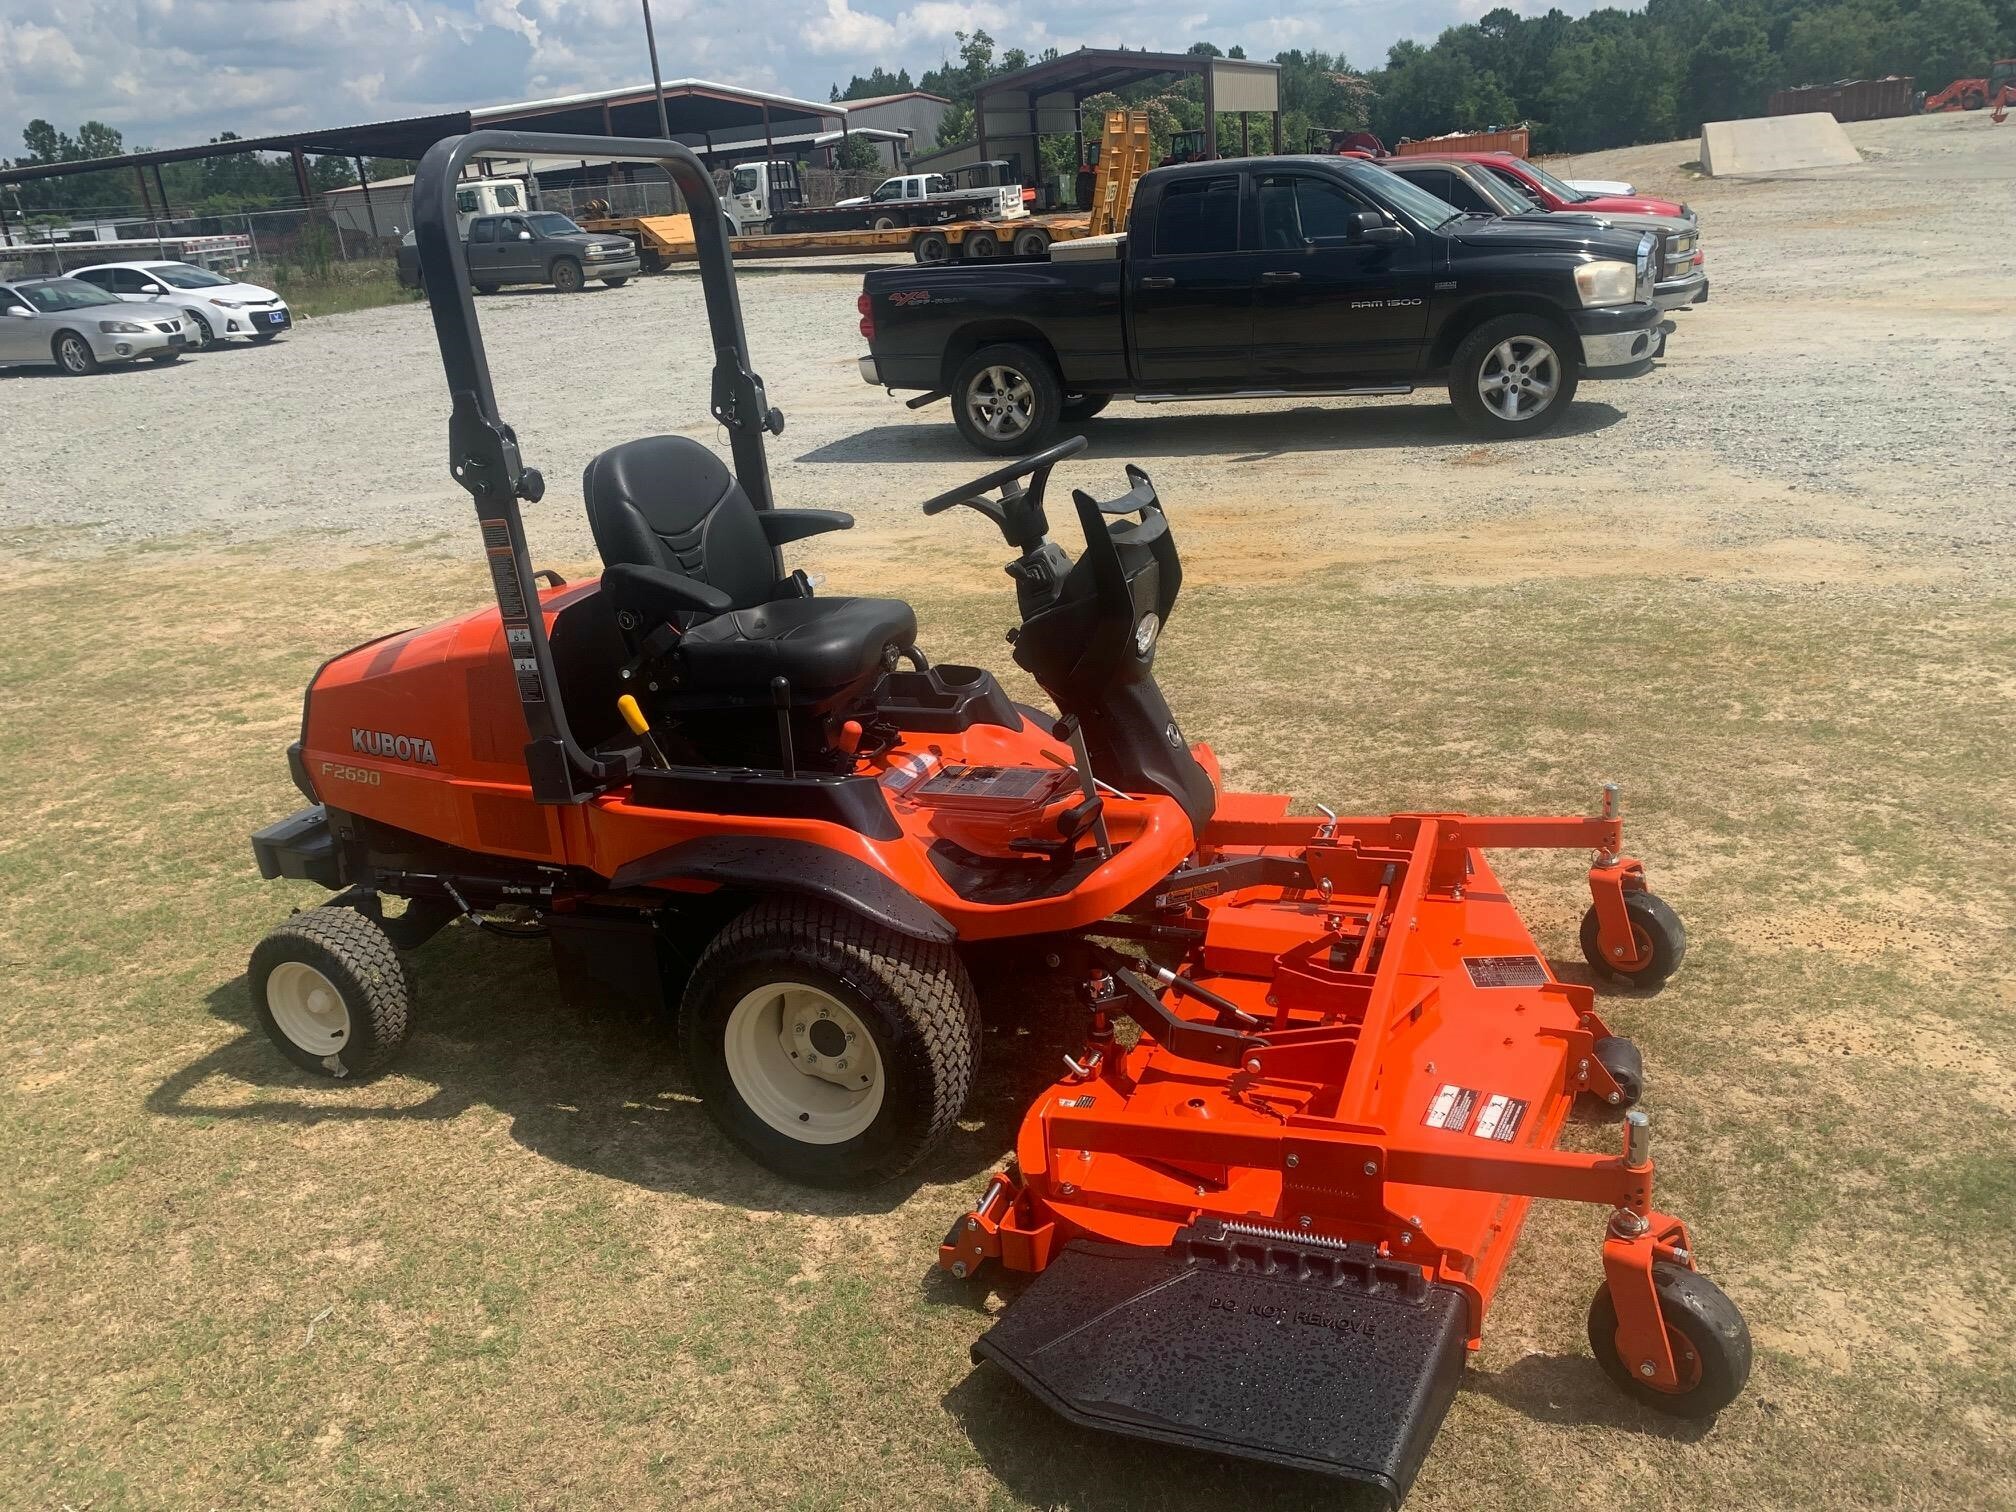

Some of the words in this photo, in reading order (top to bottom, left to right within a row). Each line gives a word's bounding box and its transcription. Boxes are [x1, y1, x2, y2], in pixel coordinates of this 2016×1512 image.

[1351, 300, 1383, 309] RAM
[1386, 298, 1422, 307] 1500
[351, 728, 438, 766] KUBOTA
[321, 762, 381, 786] F2690
[1208, 1297, 1237, 1312] DO
[1250, 1303, 1287, 1319] NOT
[1293, 1311, 1377, 1336] REMOVE
